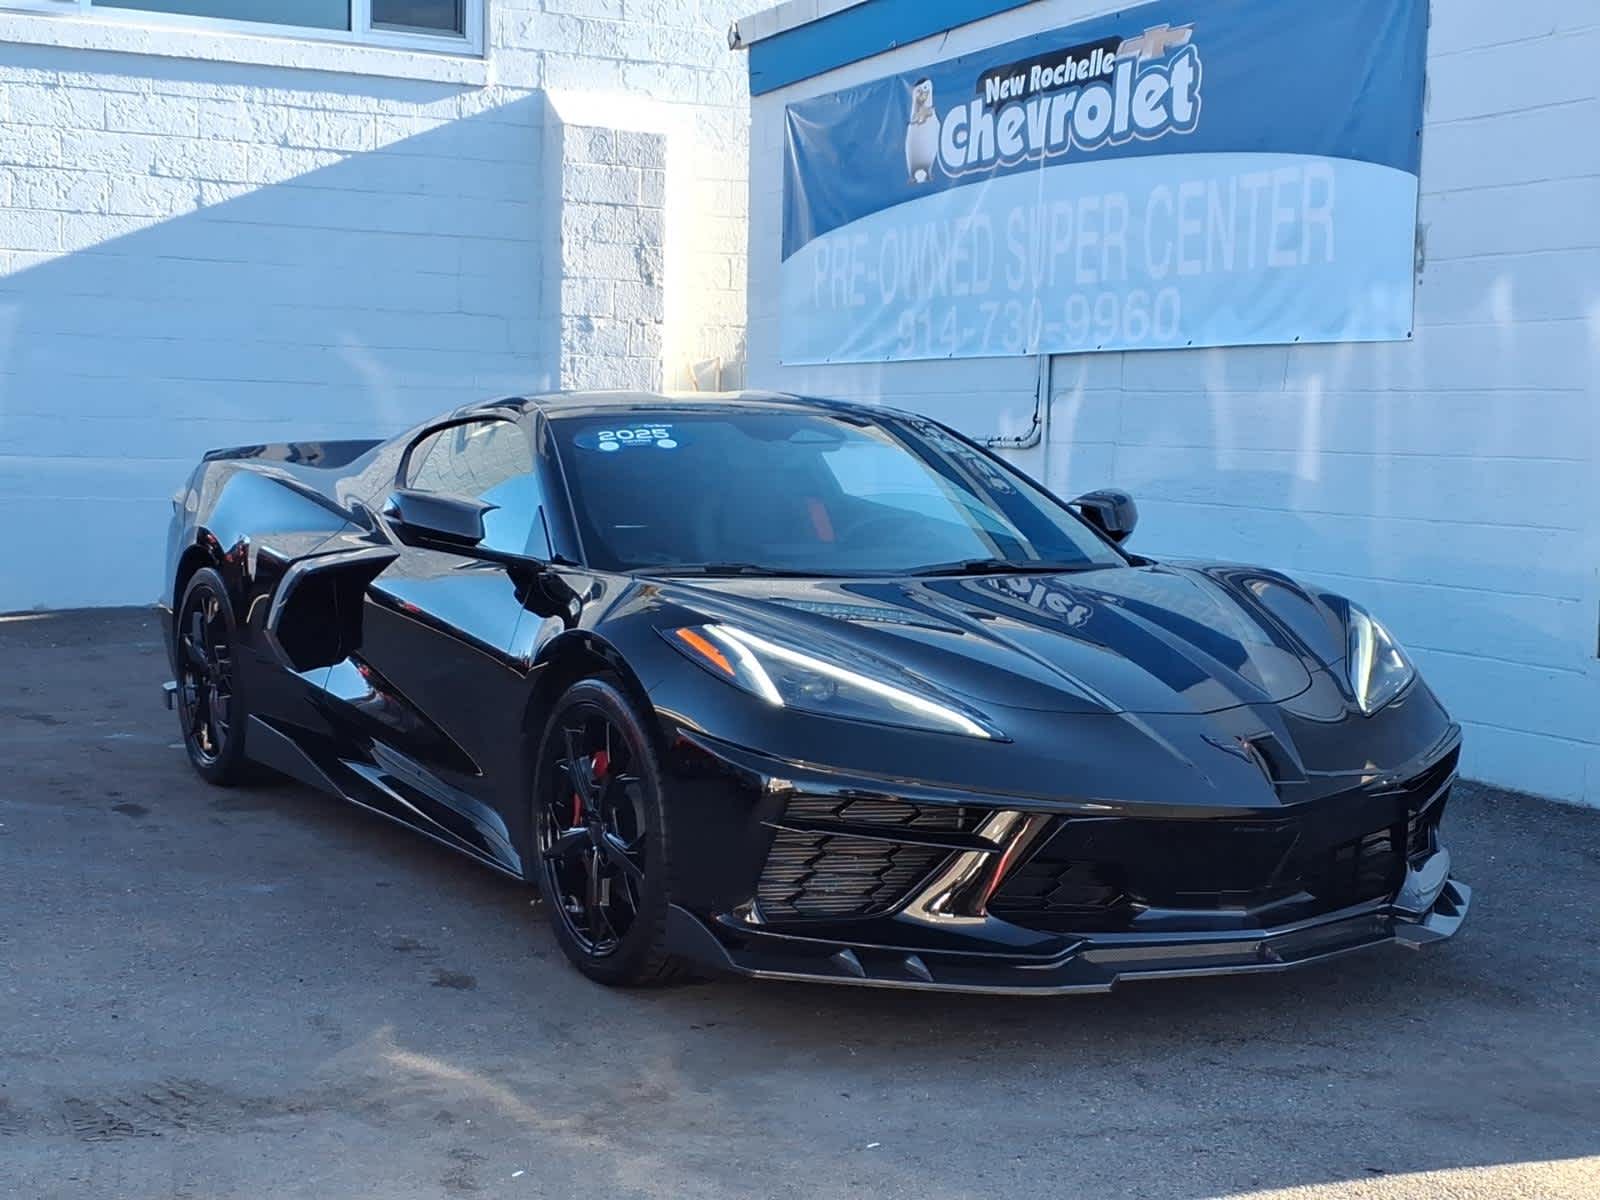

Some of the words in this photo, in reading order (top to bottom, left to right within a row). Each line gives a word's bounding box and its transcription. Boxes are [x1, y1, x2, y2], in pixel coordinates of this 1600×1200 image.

[985, 75, 1025, 103] New
[1029, 48, 1115, 91] Rochelle
[814, 213, 996, 308] PRE-OWNED
[1004, 193, 1129, 291] SUPER
[1143, 162, 1336, 279] CENTER
[898, 287, 1181, 353] 914-730-9960
[598, 429, 669, 441] 2025
